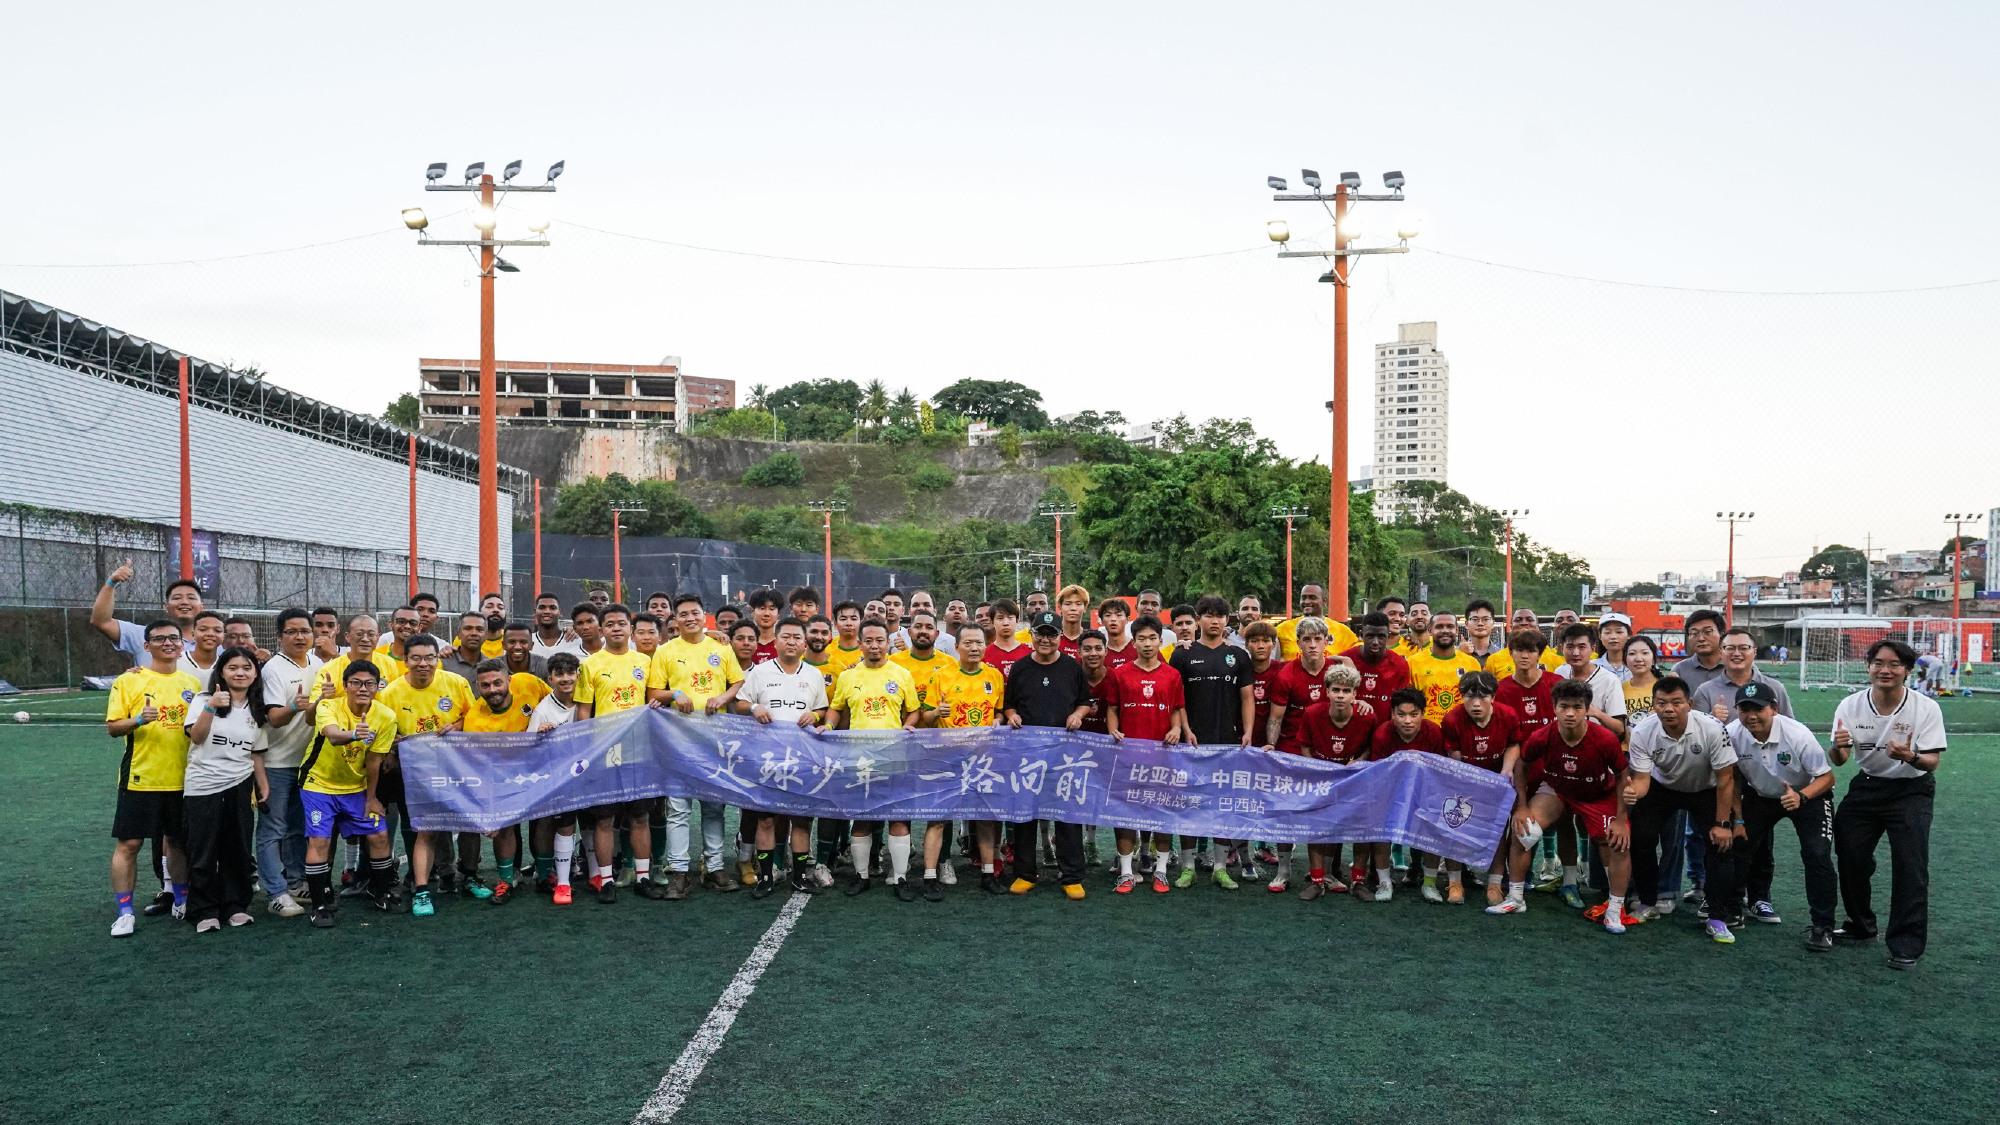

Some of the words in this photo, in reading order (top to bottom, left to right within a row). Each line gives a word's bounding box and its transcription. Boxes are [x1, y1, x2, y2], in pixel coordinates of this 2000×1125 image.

[770, 699, 807, 710] BYD
[431, 776, 482, 788] BYD
[708, 740, 890, 799] 足球少年
[918, 750, 1099, 806] 一路向前
[1824, 799, 1833, 842] ATHLETA
